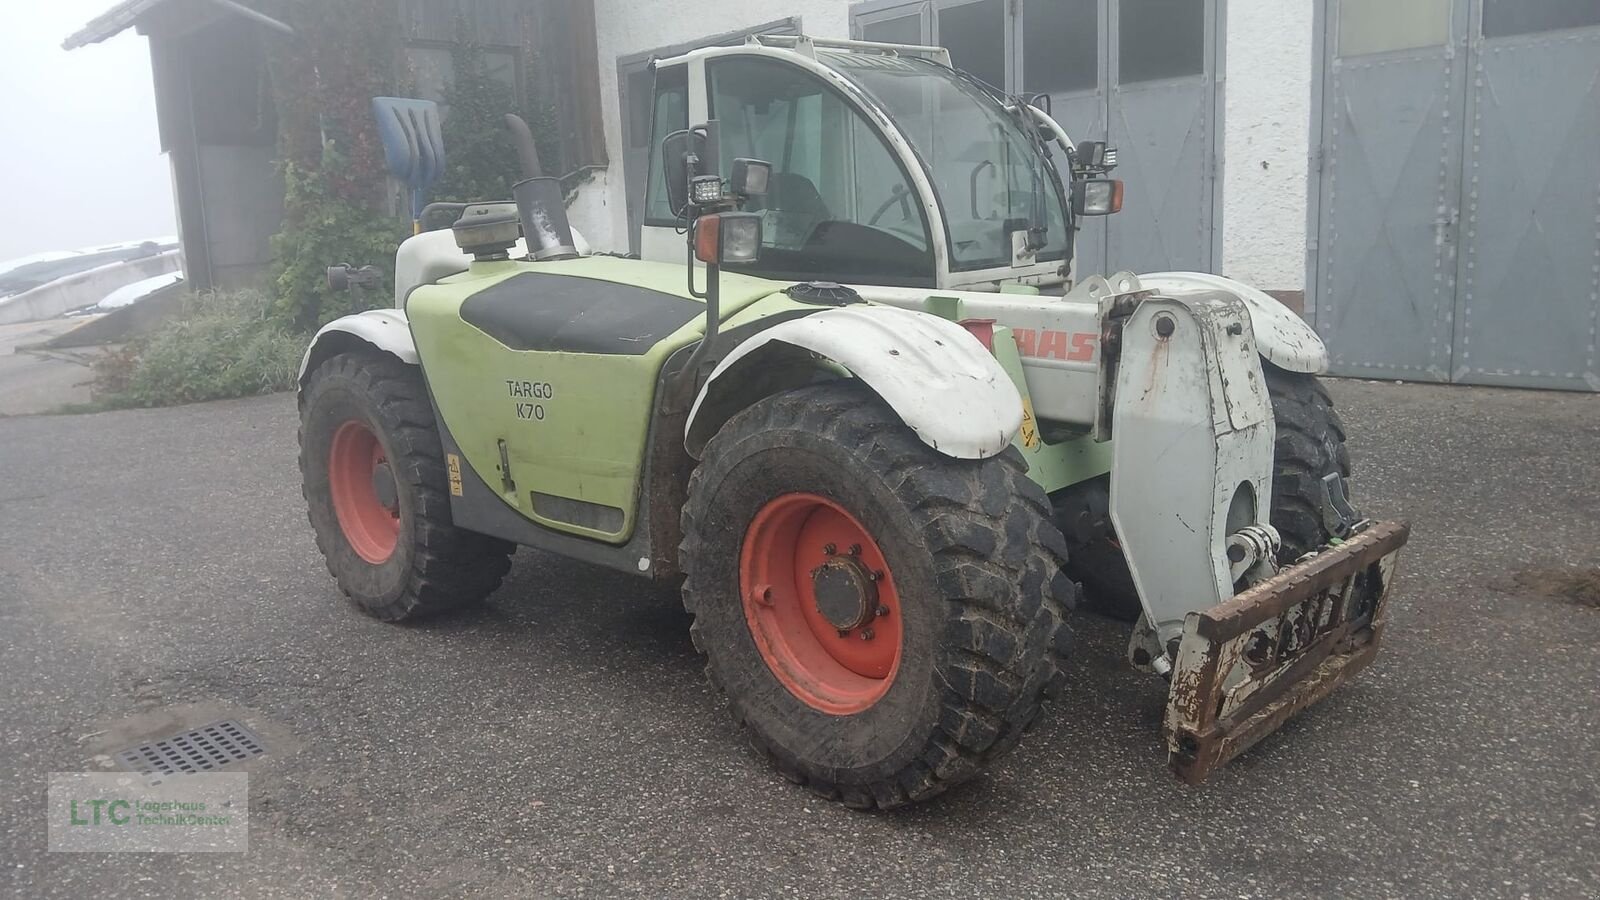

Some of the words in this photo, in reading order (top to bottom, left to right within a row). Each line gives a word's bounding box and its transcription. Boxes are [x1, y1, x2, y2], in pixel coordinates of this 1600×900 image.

[1012, 327, 1098, 362] AAS
[506, 380, 553, 399] TARGO
[516, 402, 545, 421] K70
